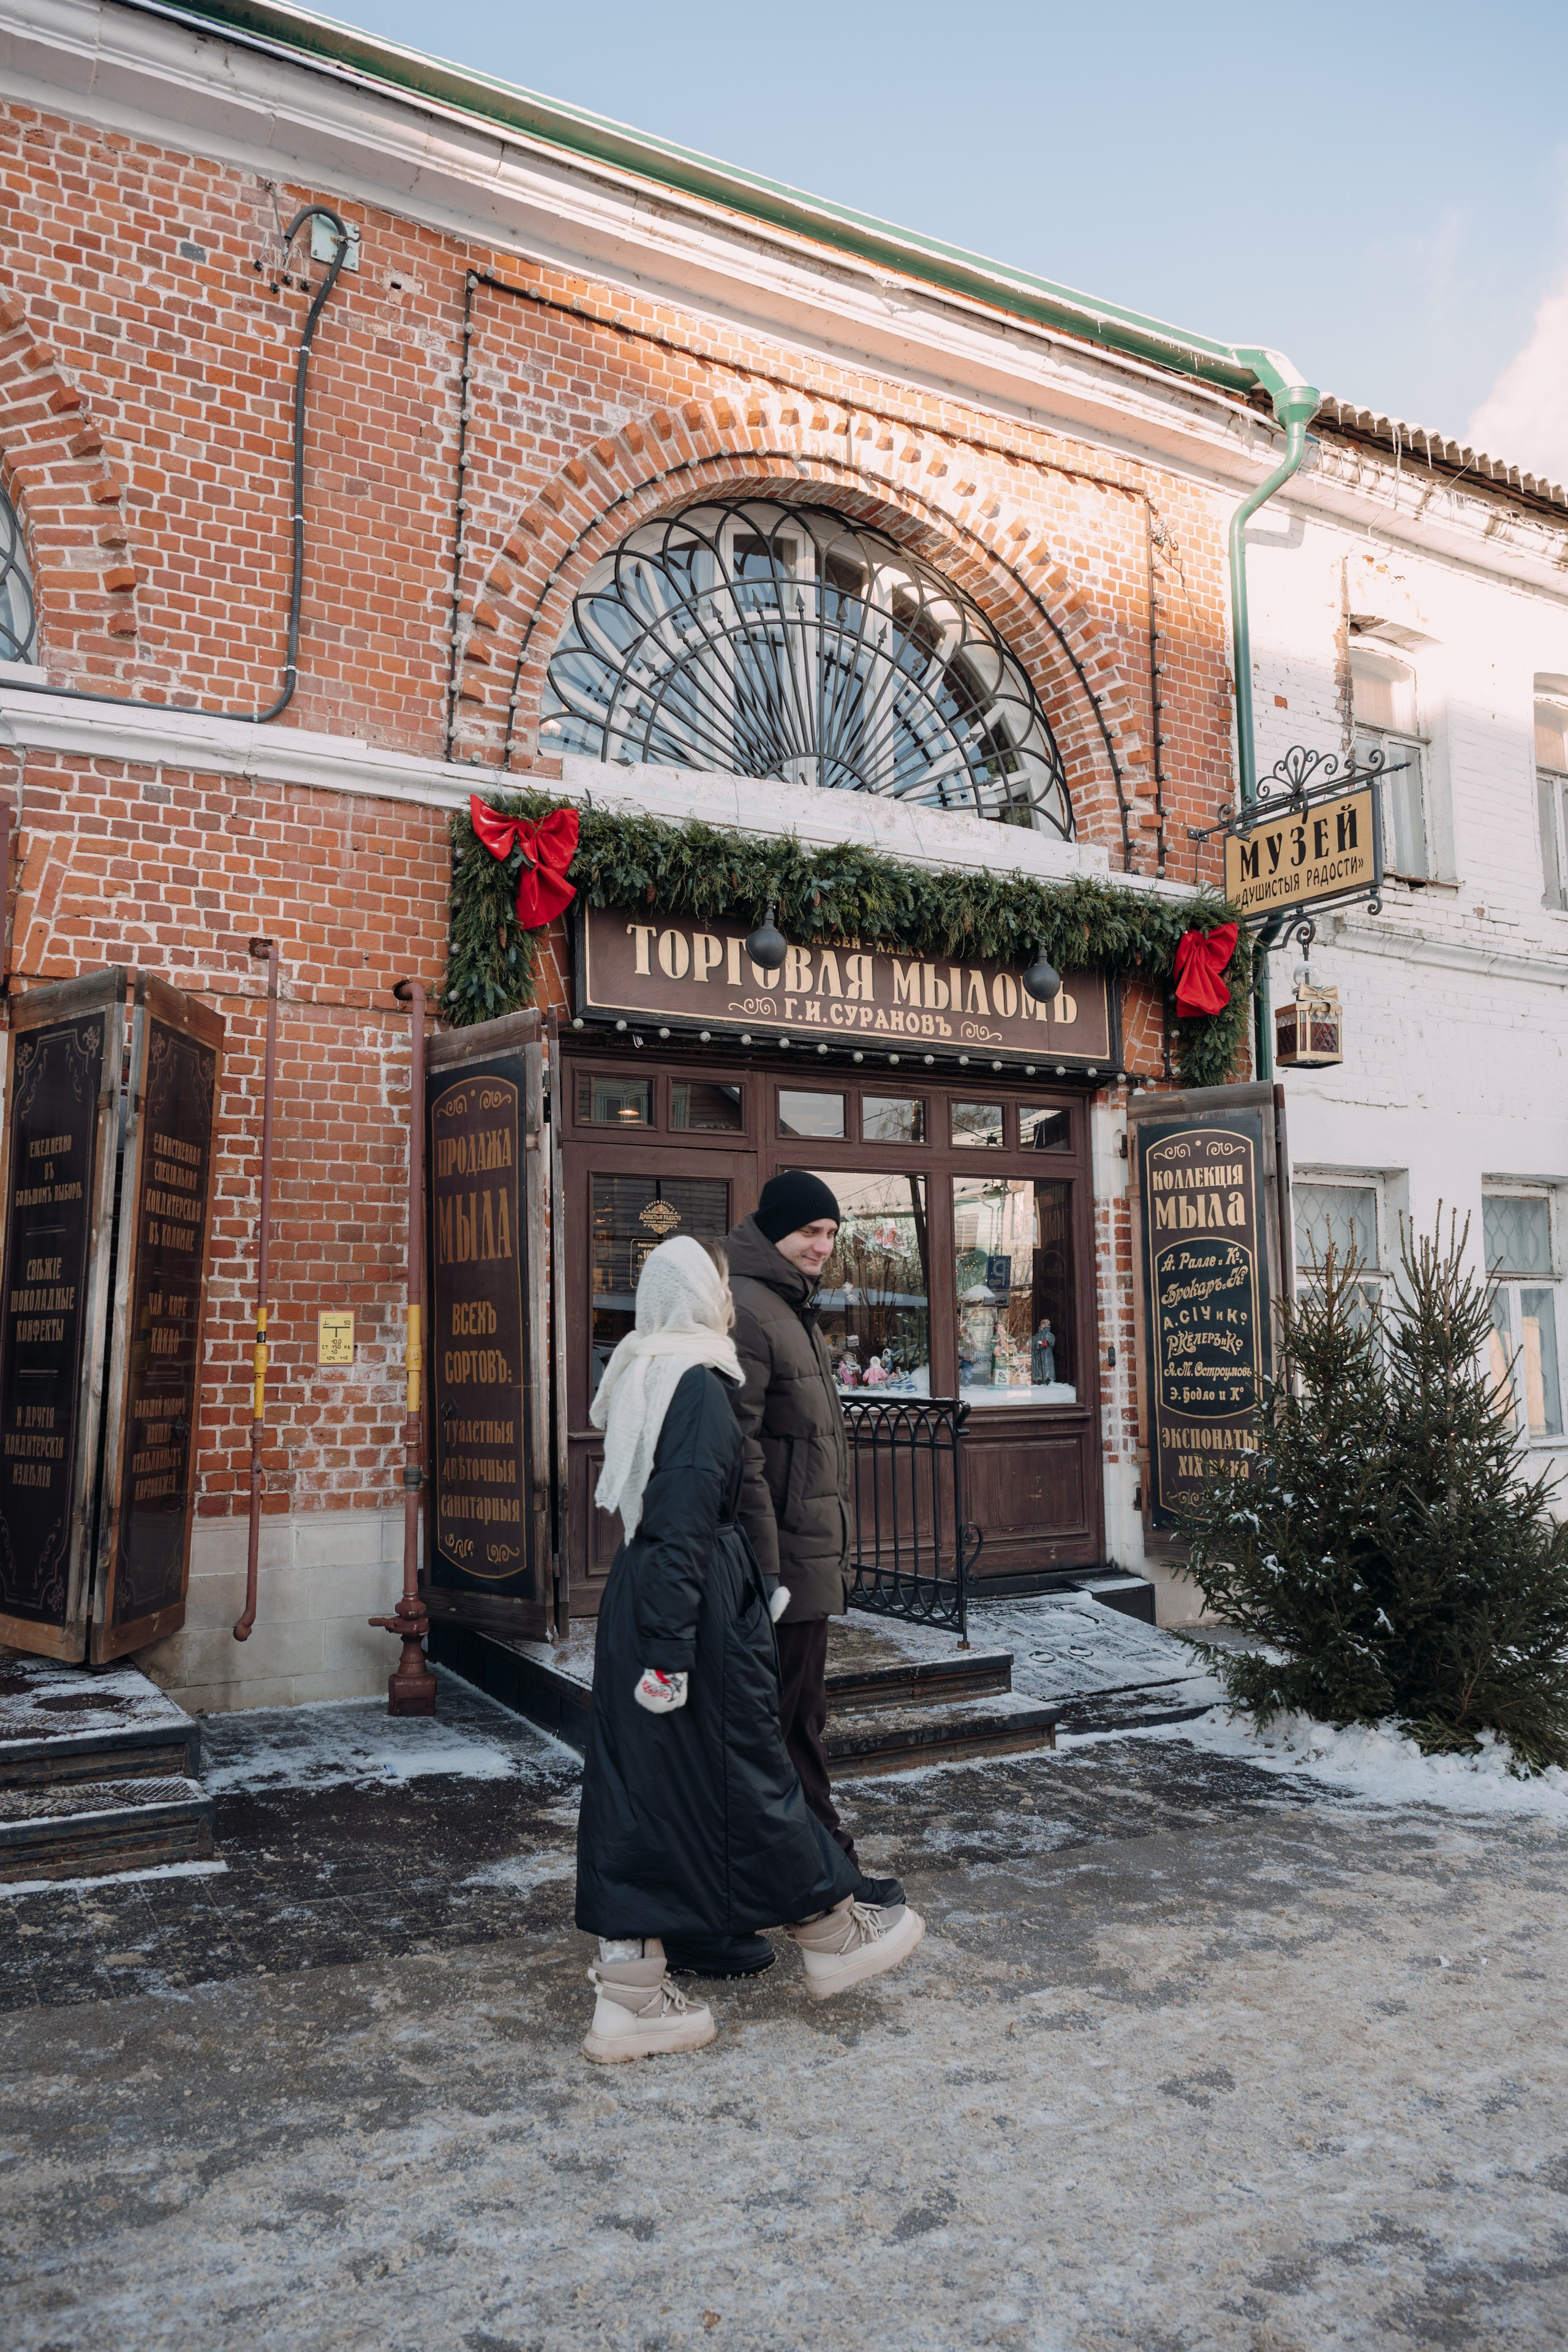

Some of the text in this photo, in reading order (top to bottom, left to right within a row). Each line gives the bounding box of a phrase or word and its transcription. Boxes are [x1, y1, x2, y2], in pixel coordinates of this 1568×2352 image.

[1240, 804, 1359, 882] МУЗЕЙ
[29, 1134, 72, 1158] ЕЖЕДНЕВНО
[153, 1132, 202, 1166] ЕДИНСТВЕННАЯ
[437, 1127, 512, 1177] ПРОДАЖА
[44, 1161, 55, 1181] ВЪ
[15, 1186, 53, 1207] БОЛЬШОМЪ
[146, 1188, 202, 1223] КОНДИТЕРСКАЯ
[149, 1221, 159, 1245] ВЪ
[438, 1187, 513, 1265] МЫЛА
[1178, 1252, 1216, 1270] Ралле
[10, 1286, 75, 1312] ШОКОЛАДНЫЕ
[149, 1289, 188, 1317] ЧАЙ КОФЕ
[16, 1319, 64, 1343] КОНФЕКТЫ
[151, 1327, 179, 1354] КАКАО
[1162, 1427, 1259, 1450] ЭКСПОНАТЫ
